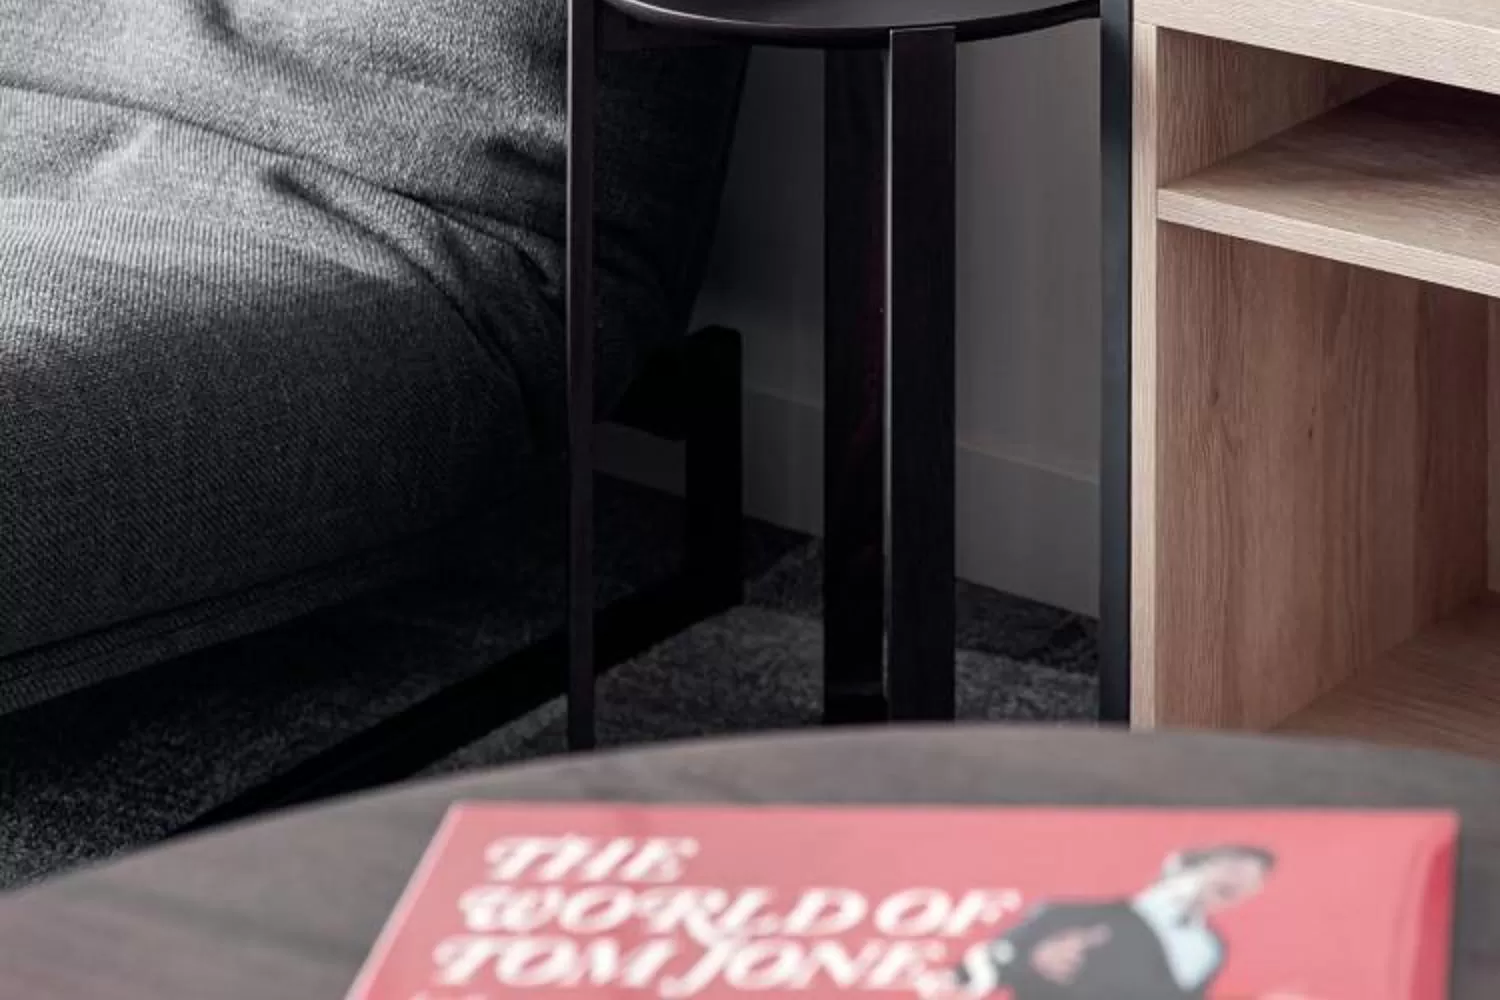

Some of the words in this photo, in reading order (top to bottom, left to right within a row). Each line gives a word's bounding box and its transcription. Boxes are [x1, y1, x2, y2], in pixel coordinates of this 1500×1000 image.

[485, 835, 699, 882] THE
[458, 886, 869, 944] WORLD
[873, 888, 1021, 936] OF
[432, 935, 681, 988] TOM
[658, 936, 1014, 998] JONES
